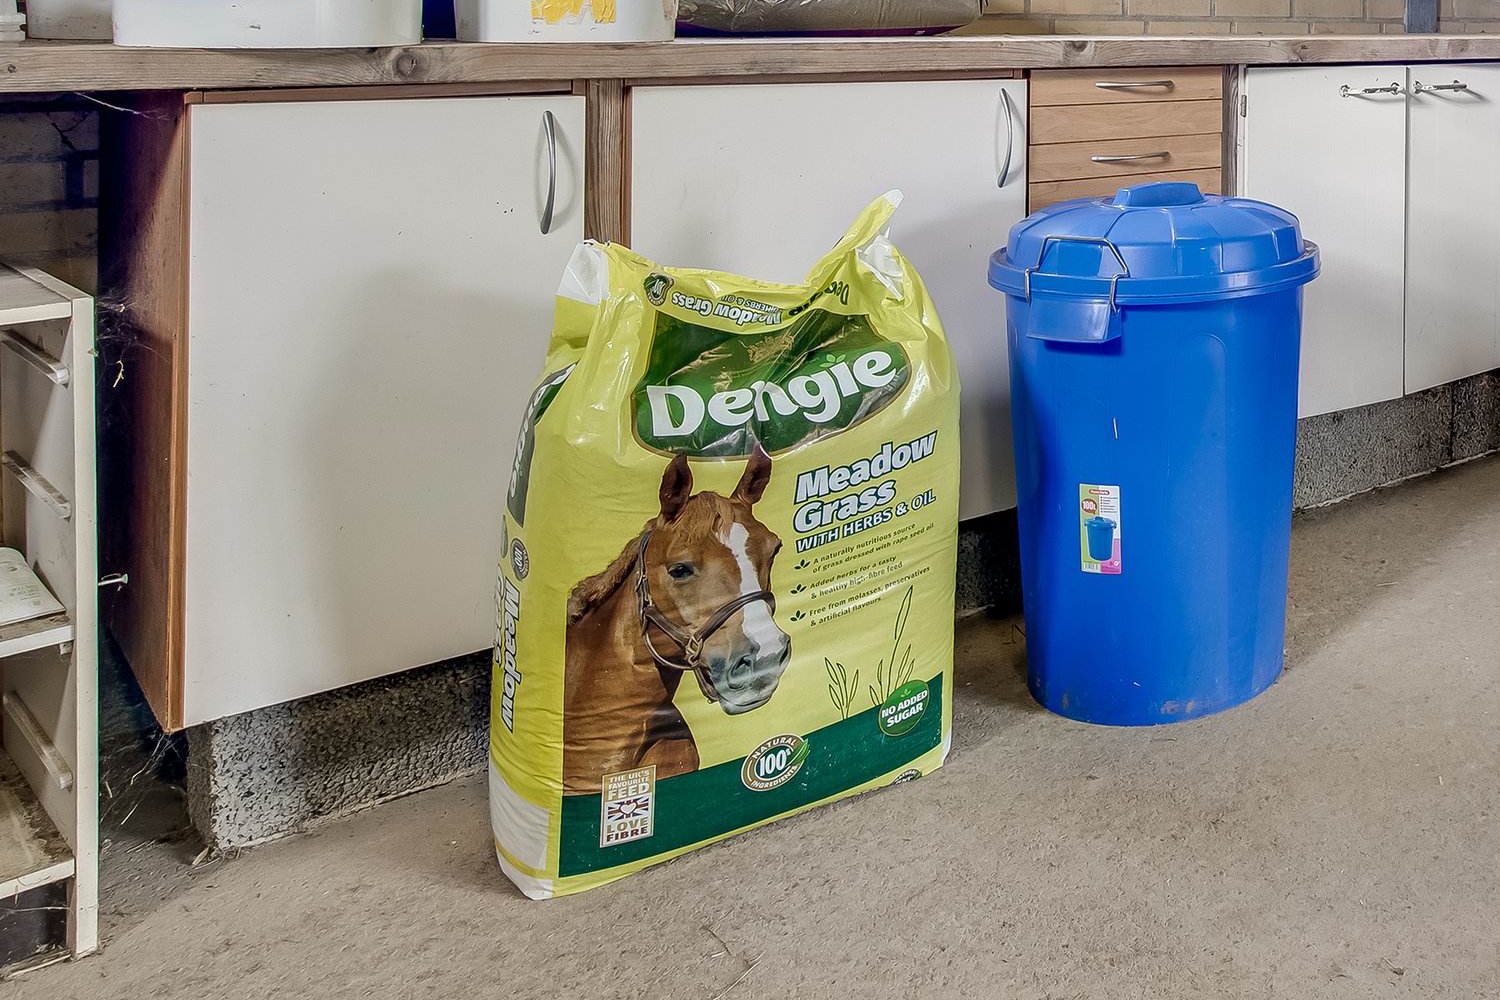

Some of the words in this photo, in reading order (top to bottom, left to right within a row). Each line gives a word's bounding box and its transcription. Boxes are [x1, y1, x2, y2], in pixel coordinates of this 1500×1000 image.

[672, 291, 712, 317] Grass
[646, 351, 896, 437] Dengie
[794, 430, 938, 505] Meadow
[794, 479, 897, 533] Grass
[796, 526, 840, 553] WITH
[842, 507, 893, 539] HERBS
[895, 502, 909, 517] &
[911, 489, 936, 512] OIL
[812, 565, 821, 574] of
[822, 560, 843, 572] grass
[845, 548, 874, 563] dressed
[876, 541, 891, 552] with
[893, 535, 908, 547] rape
[909, 527, 925, 538] seed
[926, 522, 934, 531] oil
[820, 545, 855, 562] naturally
[856, 533, 892, 549] nutritious
[893, 523, 916, 536] source
[810, 576, 835, 590] Added
[837, 569, 858, 580] herbs
[859, 564, 871, 573] for
[878, 555, 897, 567] tasty
[819, 583, 848, 598] healthy
[849, 569, 886, 586] high-fibre
[886, 561, 903, 573] feed
[809, 606, 826, 617] Free
[828, 599, 846, 610] from
[847, 587, 883, 602] molasses,
[884, 566, 930, 591] preservatives
[810, 619, 817, 627] &
[819, 607, 851, 624] artificial
[852, 597, 882, 612] flavours
[501, 576, 522, 734] Meadow
[881, 705, 896, 718] NO
[897, 690, 928, 712] ADDED
[886, 702, 924, 728] SUGAR
[752, 737, 797, 759] NATURAL
[608, 776, 650, 790] FAVOURITE
[608, 783, 650, 800] FEED
[609, 775, 626, 783] THE
[628, 770, 650, 779] UK'S
[751, 765, 798, 788] INGREDIENTS
[607, 817, 648, 833] LOVE
[607, 826, 648, 842] FIBRE
